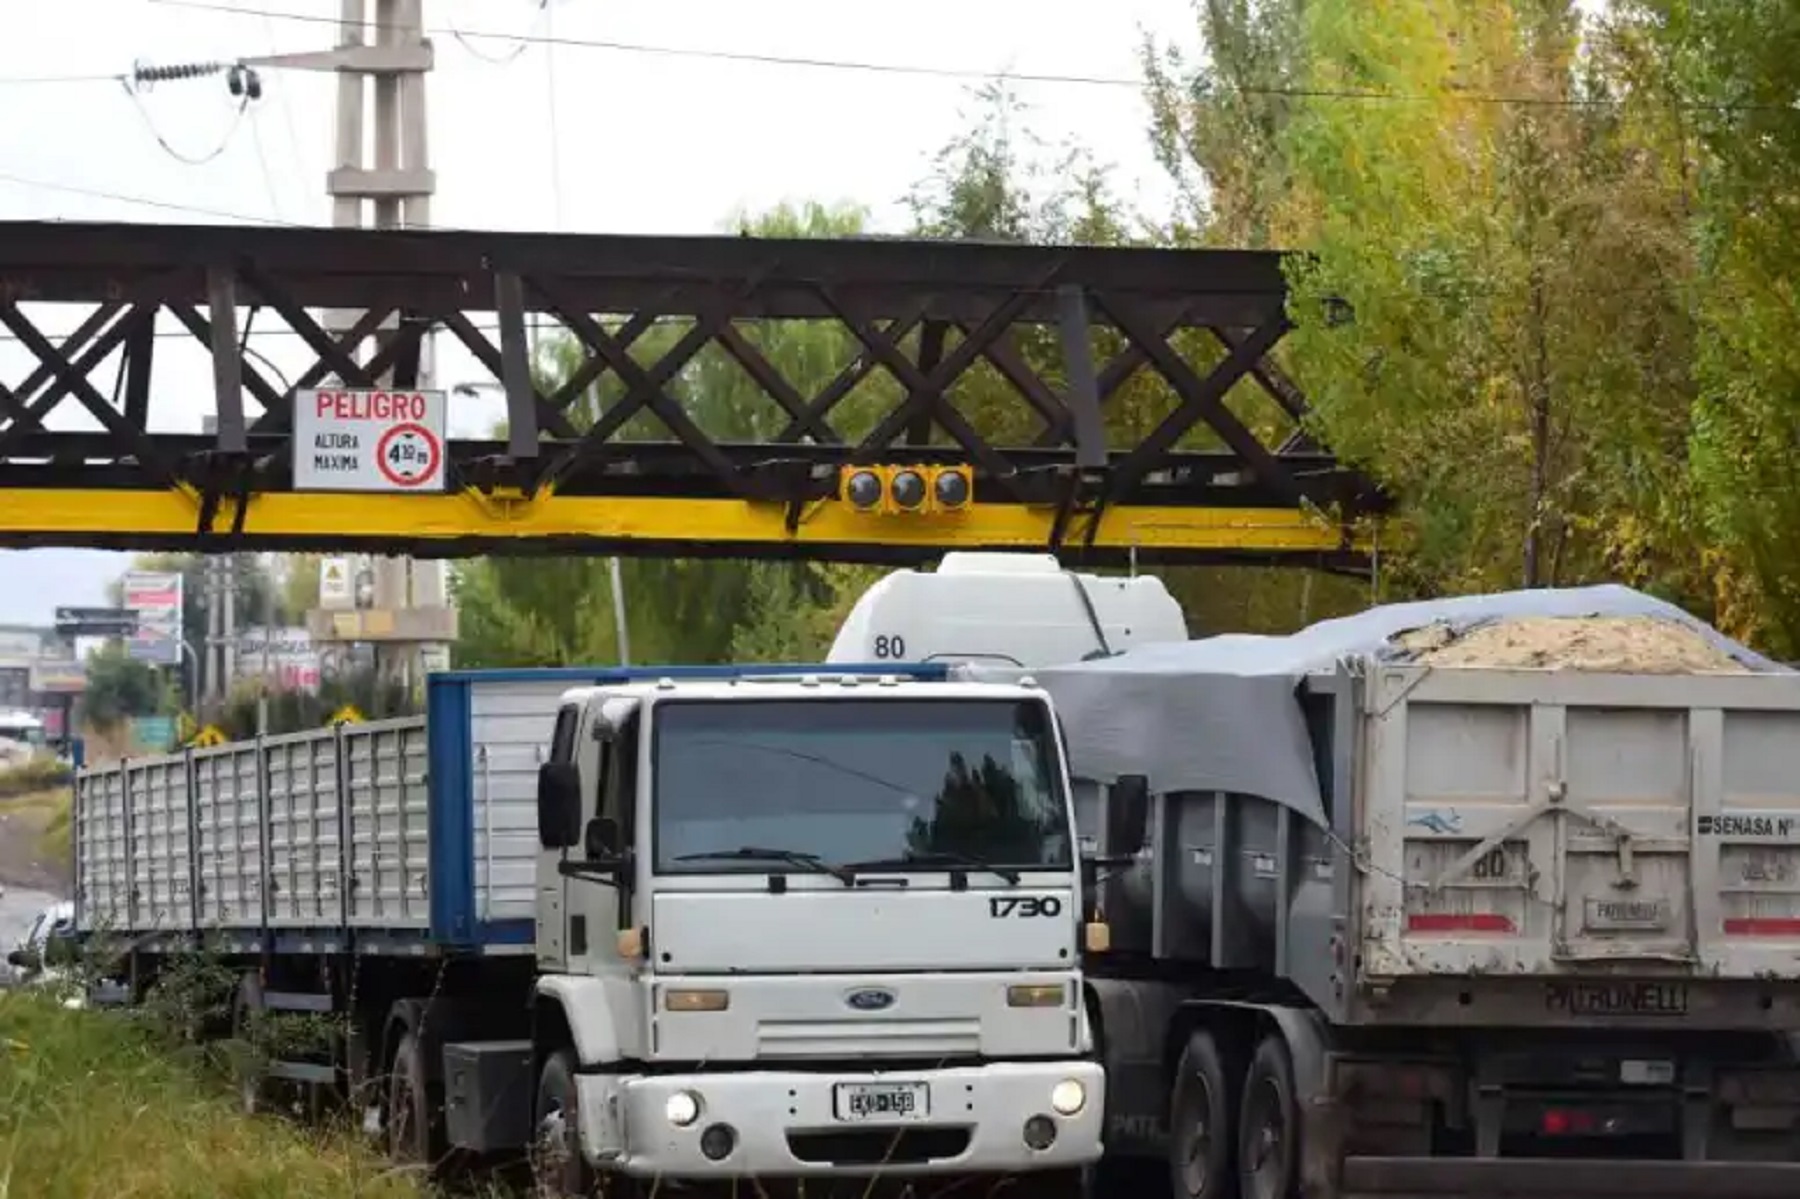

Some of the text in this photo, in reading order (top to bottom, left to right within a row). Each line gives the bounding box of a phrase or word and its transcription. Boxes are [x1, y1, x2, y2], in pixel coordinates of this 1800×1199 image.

[316, 393, 426, 420] PELIGRO
[314, 434, 359, 449] ALTURA
[314, 455, 359, 470] MAXIMA
[875, 634, 905, 659] 80
[1713, 816, 1772, 836] SENASA
[989, 896, 1062, 918] 1730
